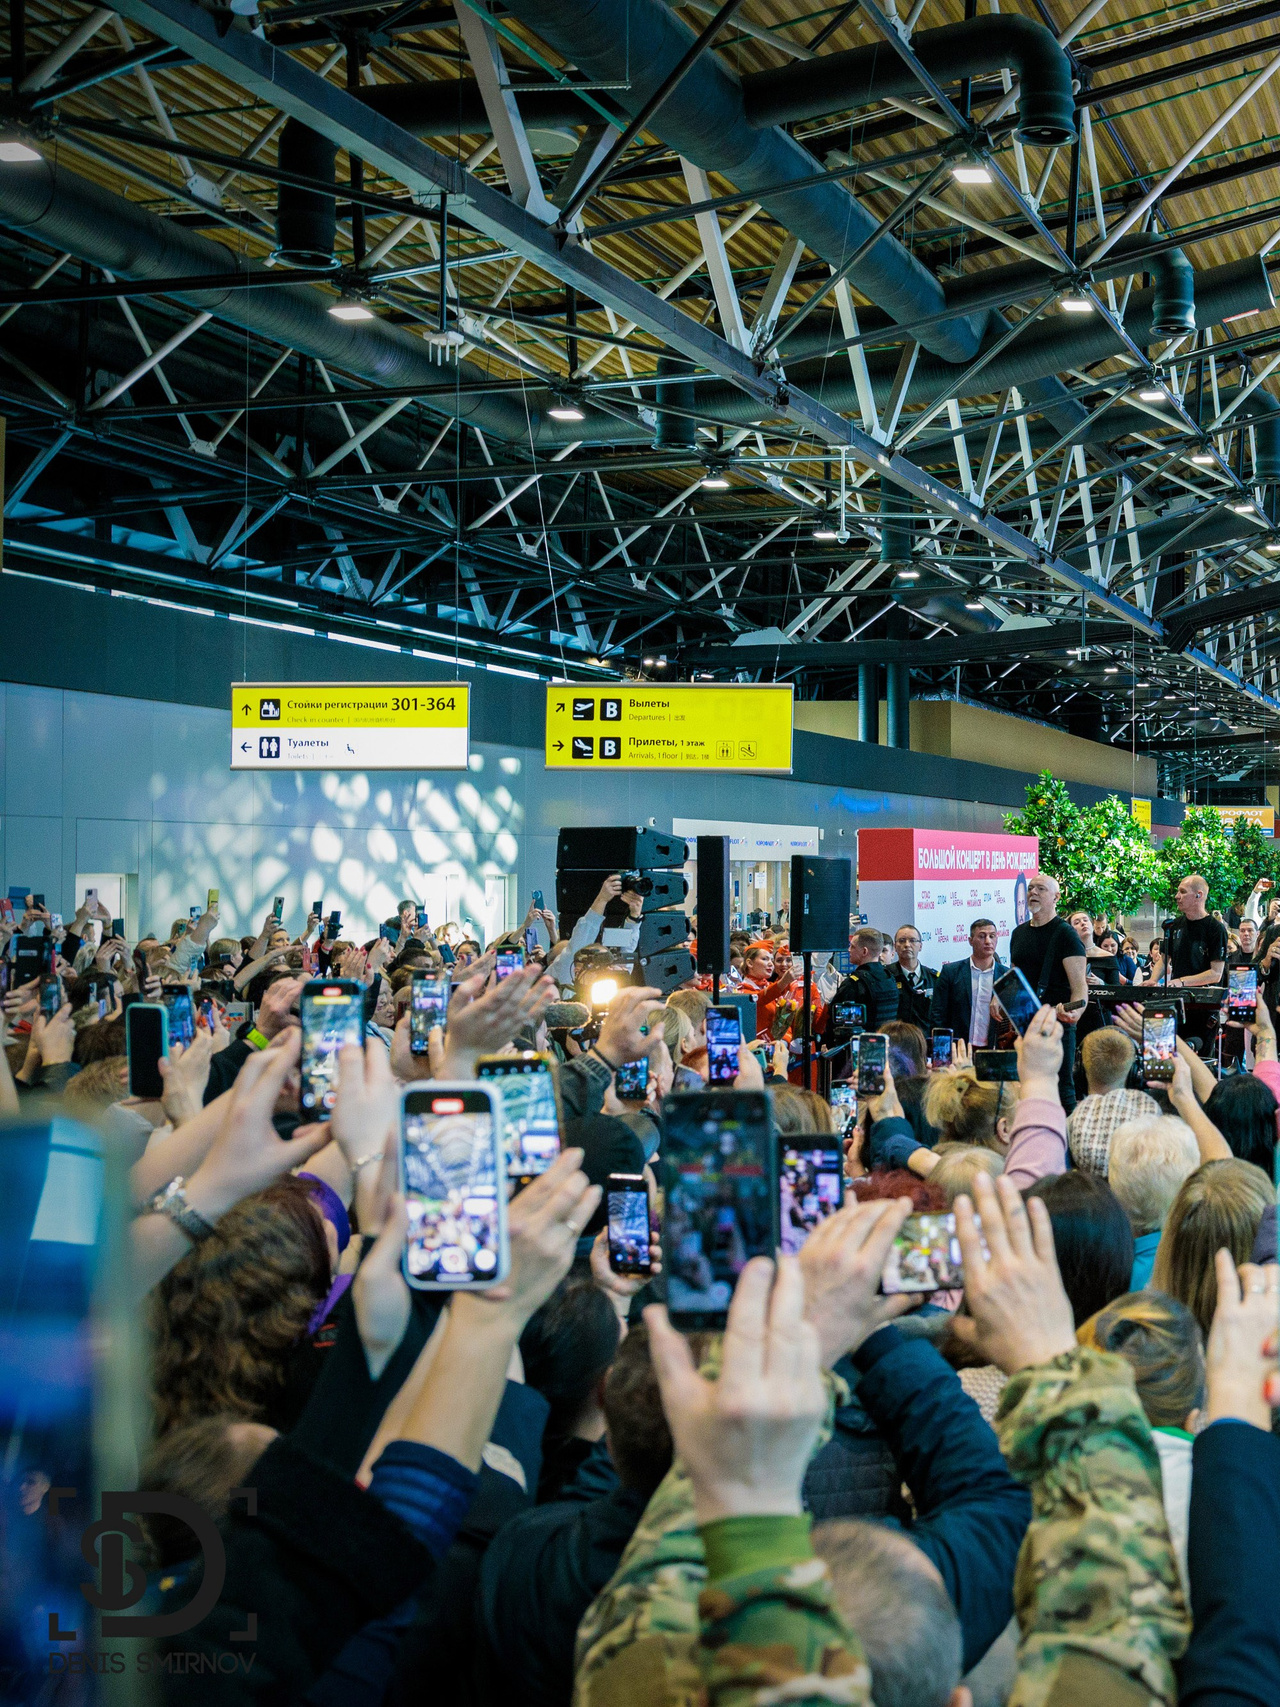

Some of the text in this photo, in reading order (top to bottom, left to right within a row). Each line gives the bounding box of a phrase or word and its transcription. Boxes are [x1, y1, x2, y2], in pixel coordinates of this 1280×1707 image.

[287, 697, 456, 711] Стойки регистрации 301-364
[629, 699, 670, 708] Вылеты
[628, 713, 666, 722] Departures
[287, 738, 329, 748] Туалеты
[628, 737, 678, 748] Прилеты,
[628, 752, 656, 760] Arrivals,
[918, 845, 1036, 873] БОЛЬШОЙ КОНЦЕРТ В ДЕНЬ РОЖДЕНИЯ
